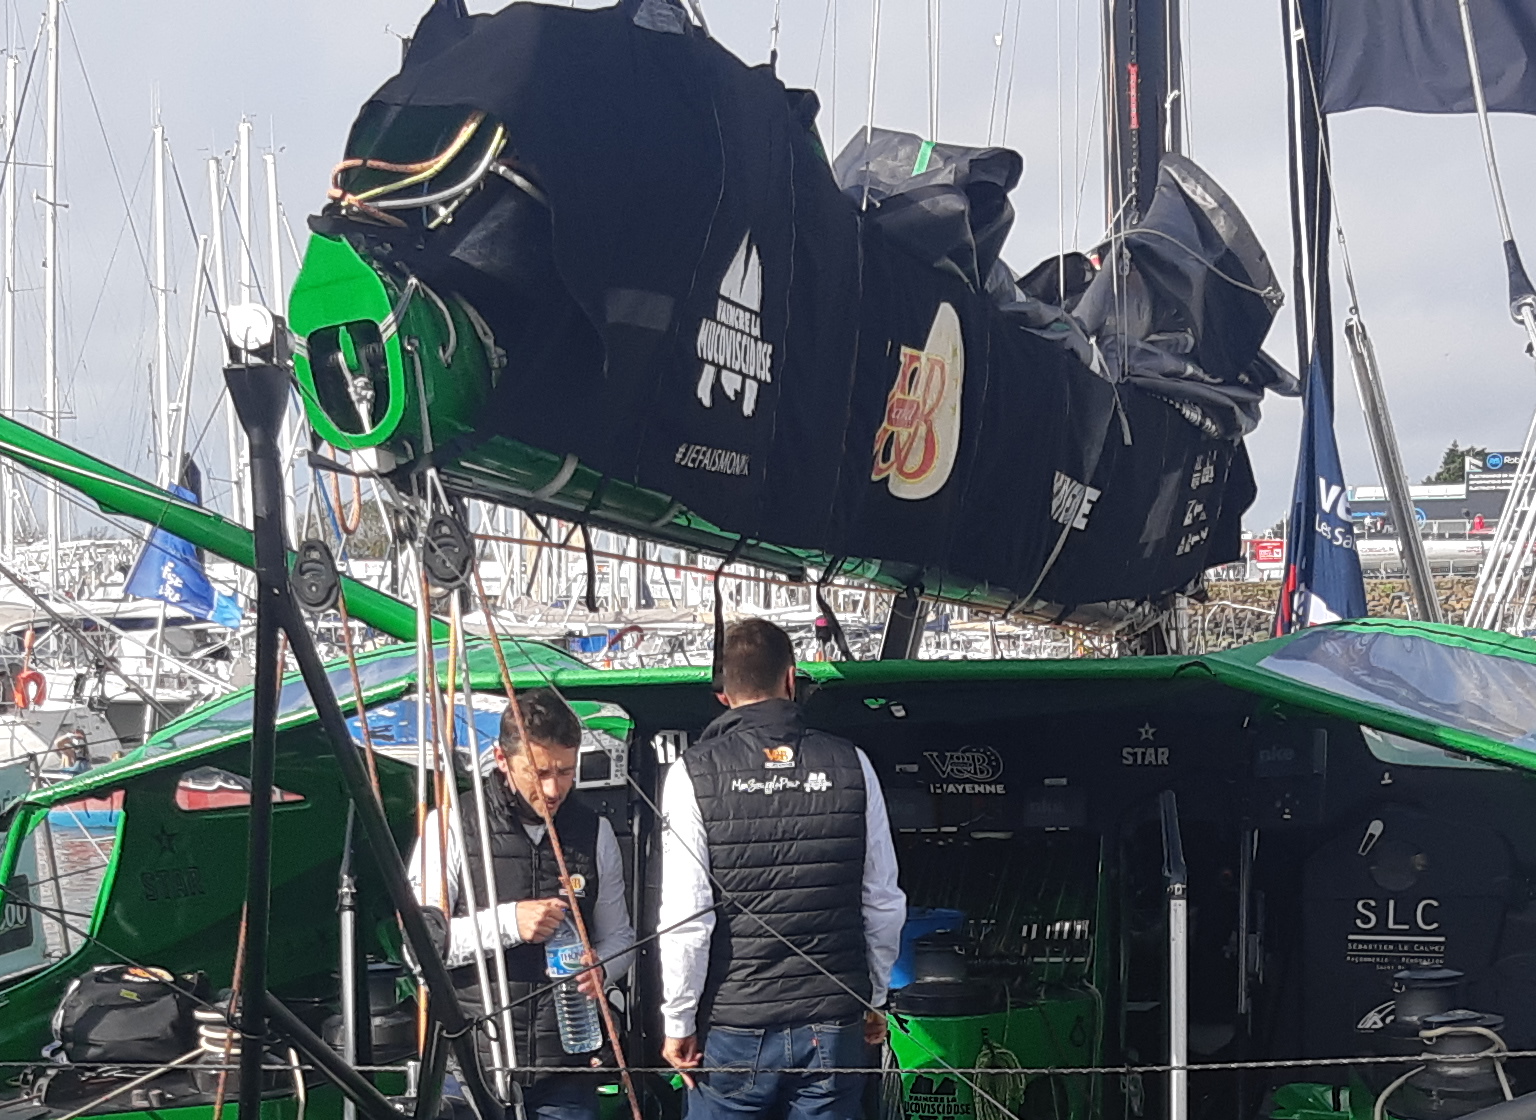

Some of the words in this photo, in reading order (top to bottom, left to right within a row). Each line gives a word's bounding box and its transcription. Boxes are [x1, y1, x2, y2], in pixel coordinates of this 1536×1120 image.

[1121, 747, 1170, 766] STAR
[930, 783, 1006, 795] MAYENNE
[1355, 898, 1440, 930] SLC
